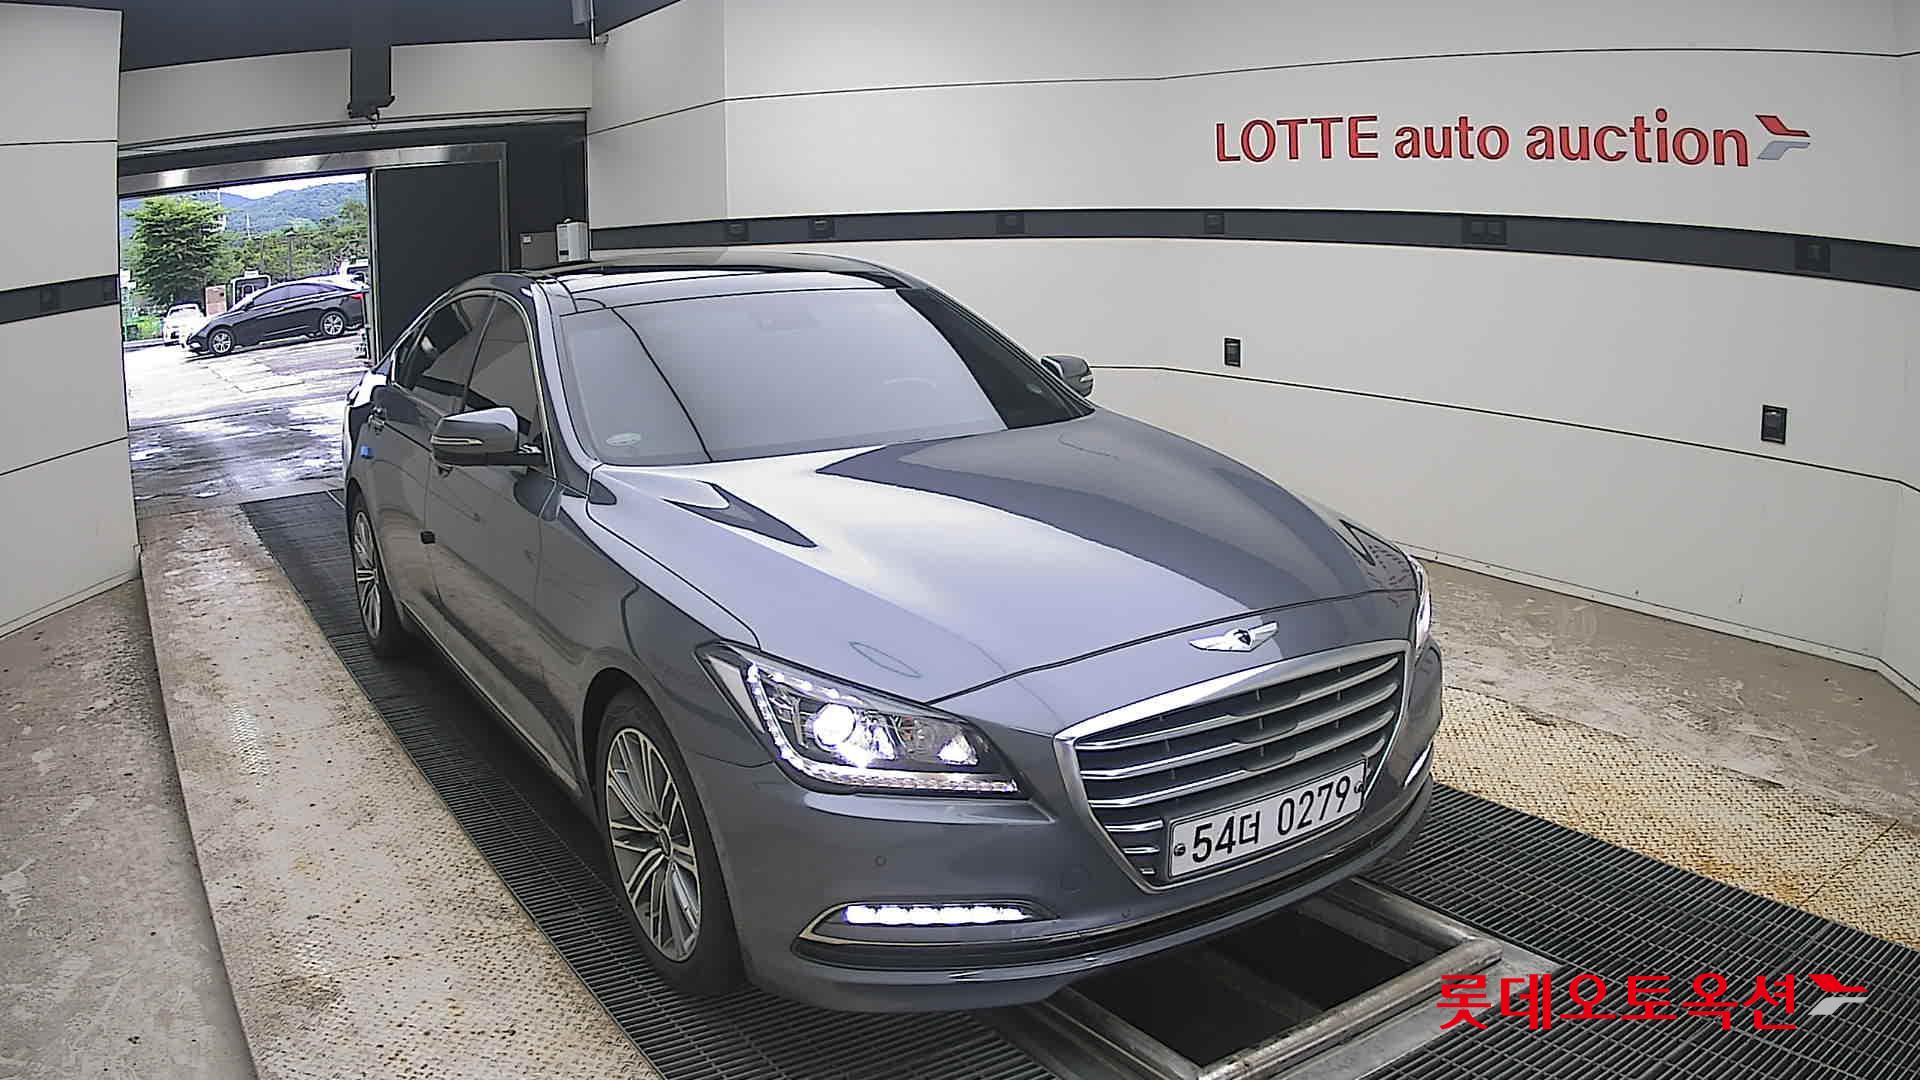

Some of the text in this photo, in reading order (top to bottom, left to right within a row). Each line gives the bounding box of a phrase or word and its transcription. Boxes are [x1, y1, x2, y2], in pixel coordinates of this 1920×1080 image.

[1216, 108, 1750, 168] LOTTE auto auction
[1192, 775, 1351, 863] 54더 0279
